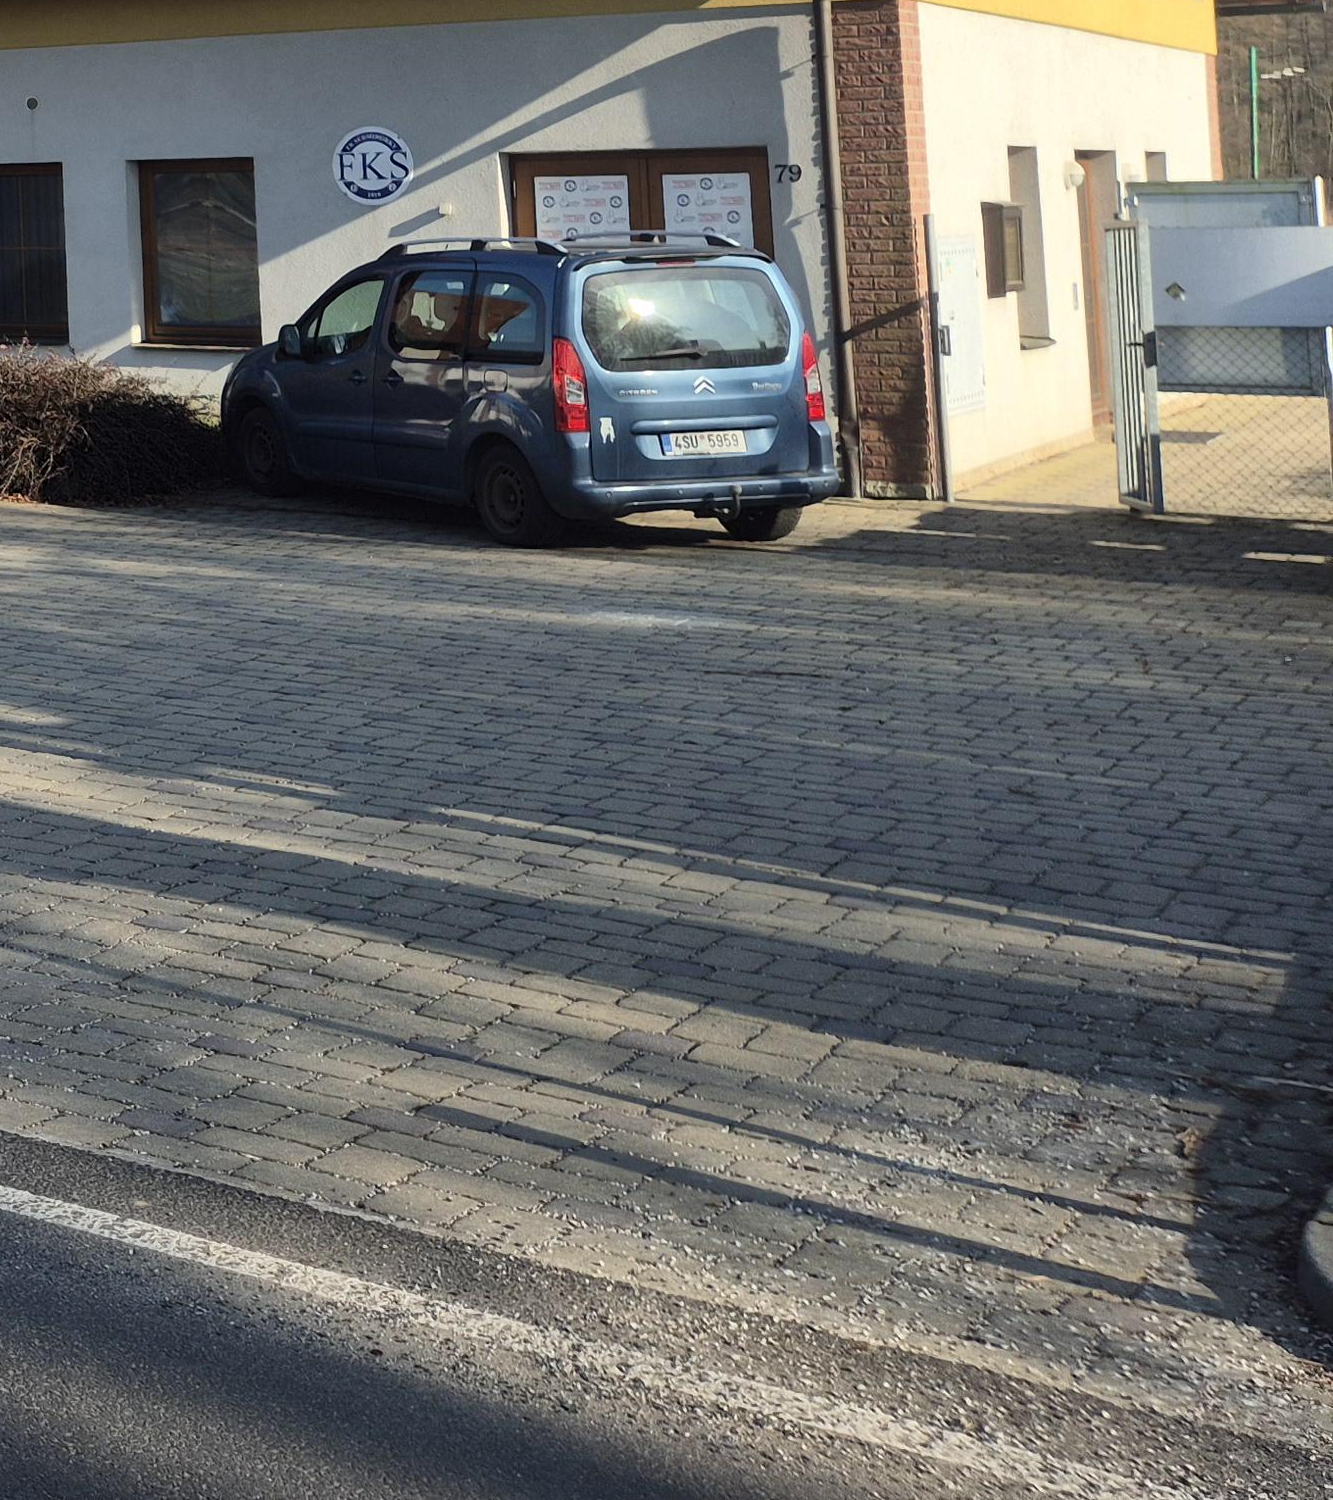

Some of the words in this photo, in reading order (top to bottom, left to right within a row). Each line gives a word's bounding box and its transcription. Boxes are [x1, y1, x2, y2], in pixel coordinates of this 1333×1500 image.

[337, 151, 410, 181] FKS
[774, 164, 802, 184] 79
[674, 434, 699, 450] 4SU
[708, 432, 739, 449] 5959
